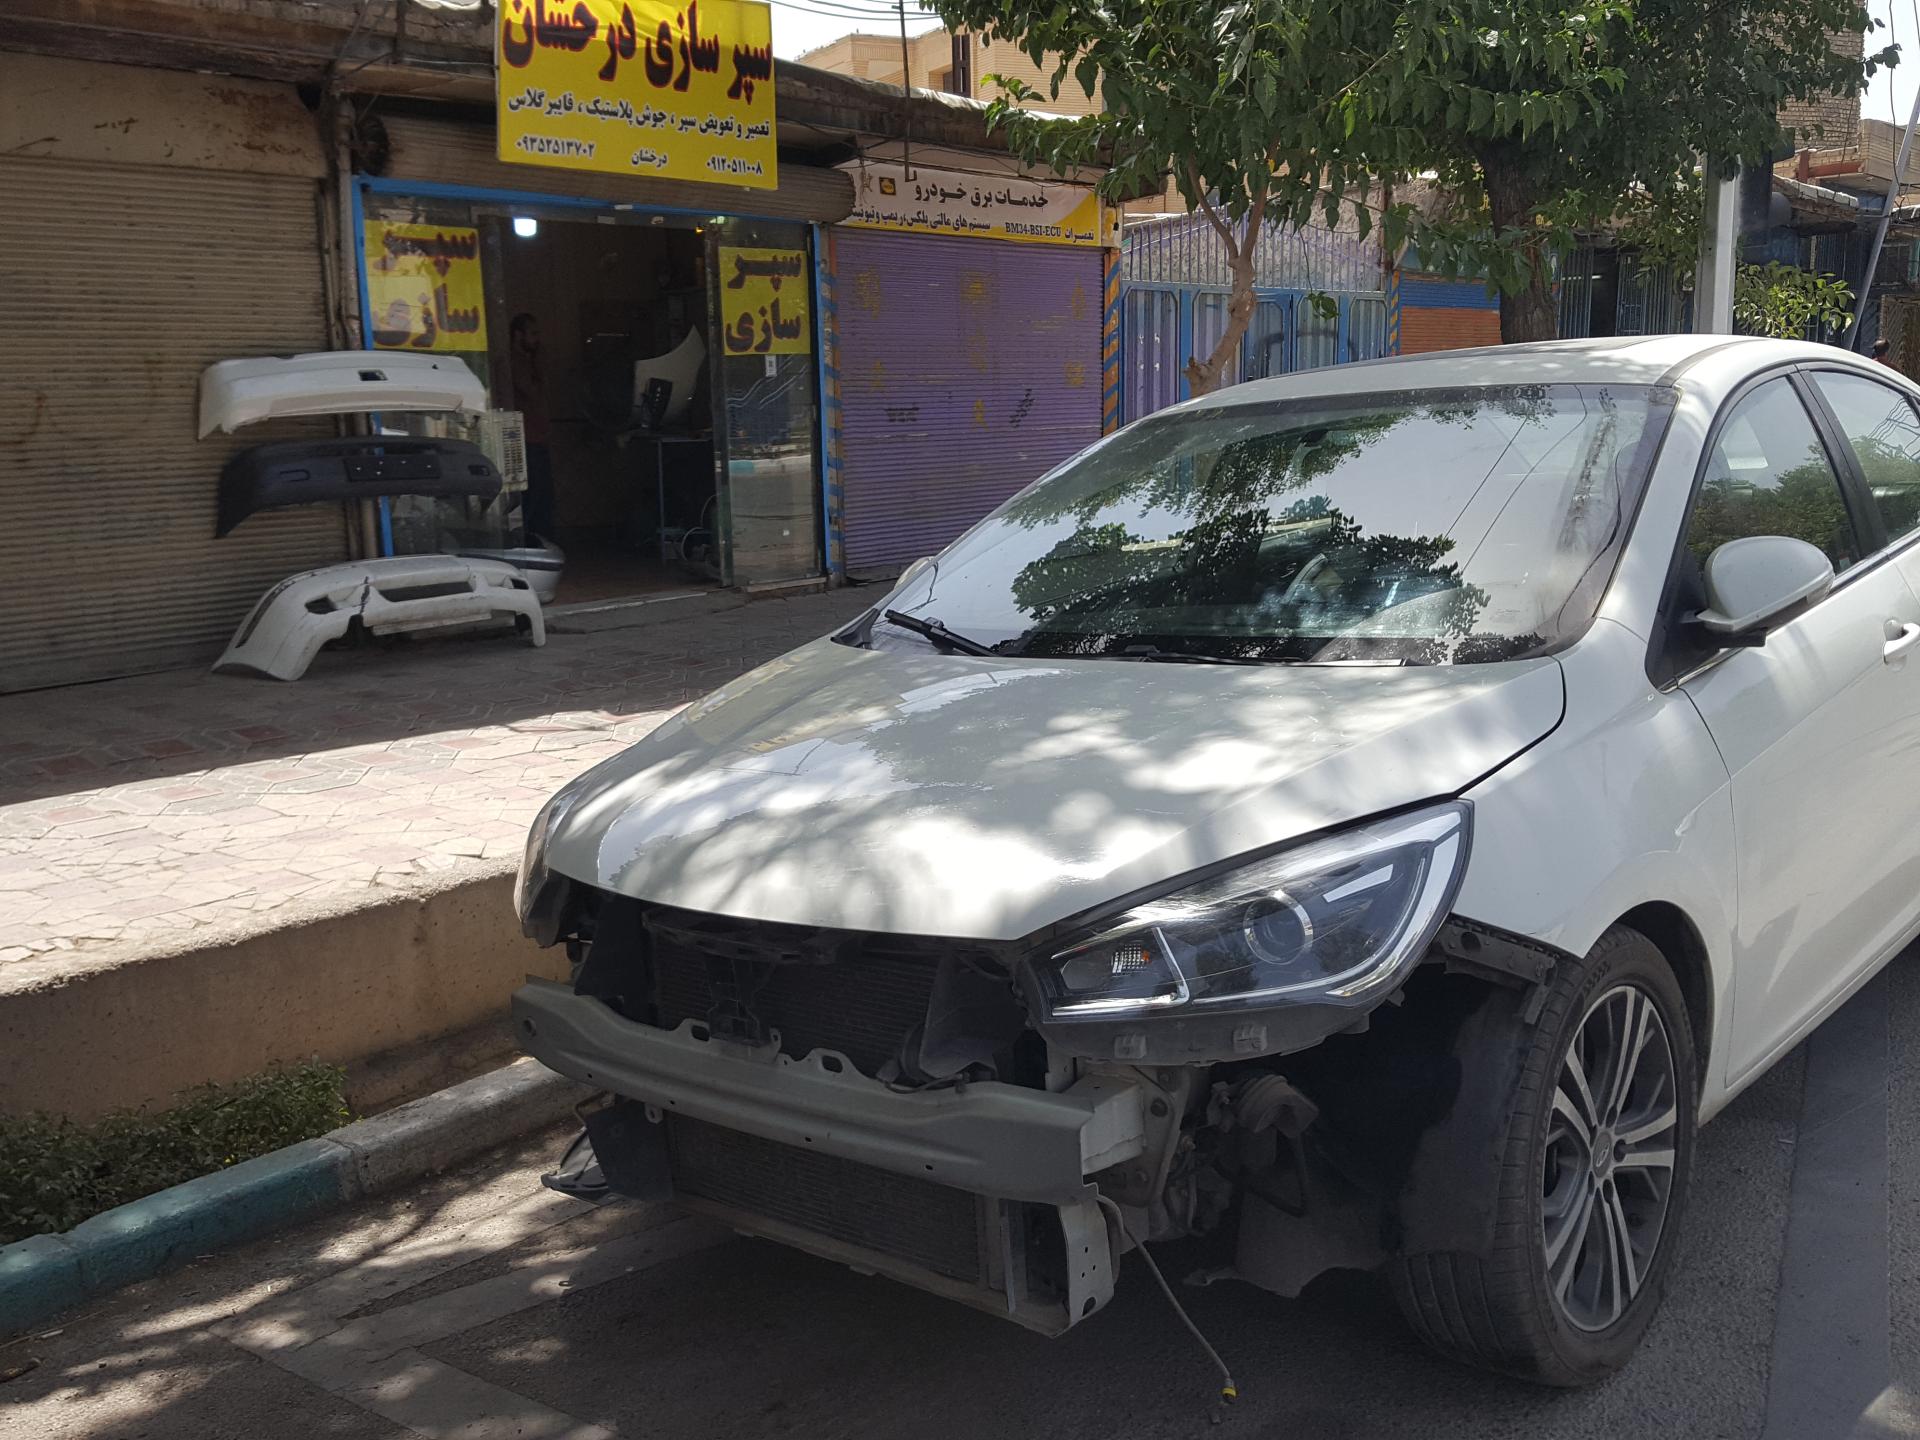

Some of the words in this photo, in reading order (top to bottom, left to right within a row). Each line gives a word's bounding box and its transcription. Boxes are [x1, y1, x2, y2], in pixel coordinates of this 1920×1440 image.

[645, 0, 720, 92] سازی
[727, 43, 772, 105] سپر
[508, 88, 545, 111] گلاس
[545, 93, 574, 116] فایبر
[636, 105, 667, 128] جوش
[699, 114, 734, 136] تعویض
[736, 123, 742, 138] و
[745, 120, 770, 140] تعمیر
[631, 149, 668, 168] درخشان
[914, 182, 967, 203] خودرو
[970, 187, 993, 208] برق
[995, 188, 1049, 208] خدمات
[952, 214, 968, 231] های
[969, 218, 991, 233] سیستم
[1004, 222, 1062, 237] BM34-BSI-ECU
[373, 229, 478, 277] سپر
[727, 252, 803, 291] سپر
[371, 284, 480, 347] سازی
[725, 297, 802, 353] سازی
